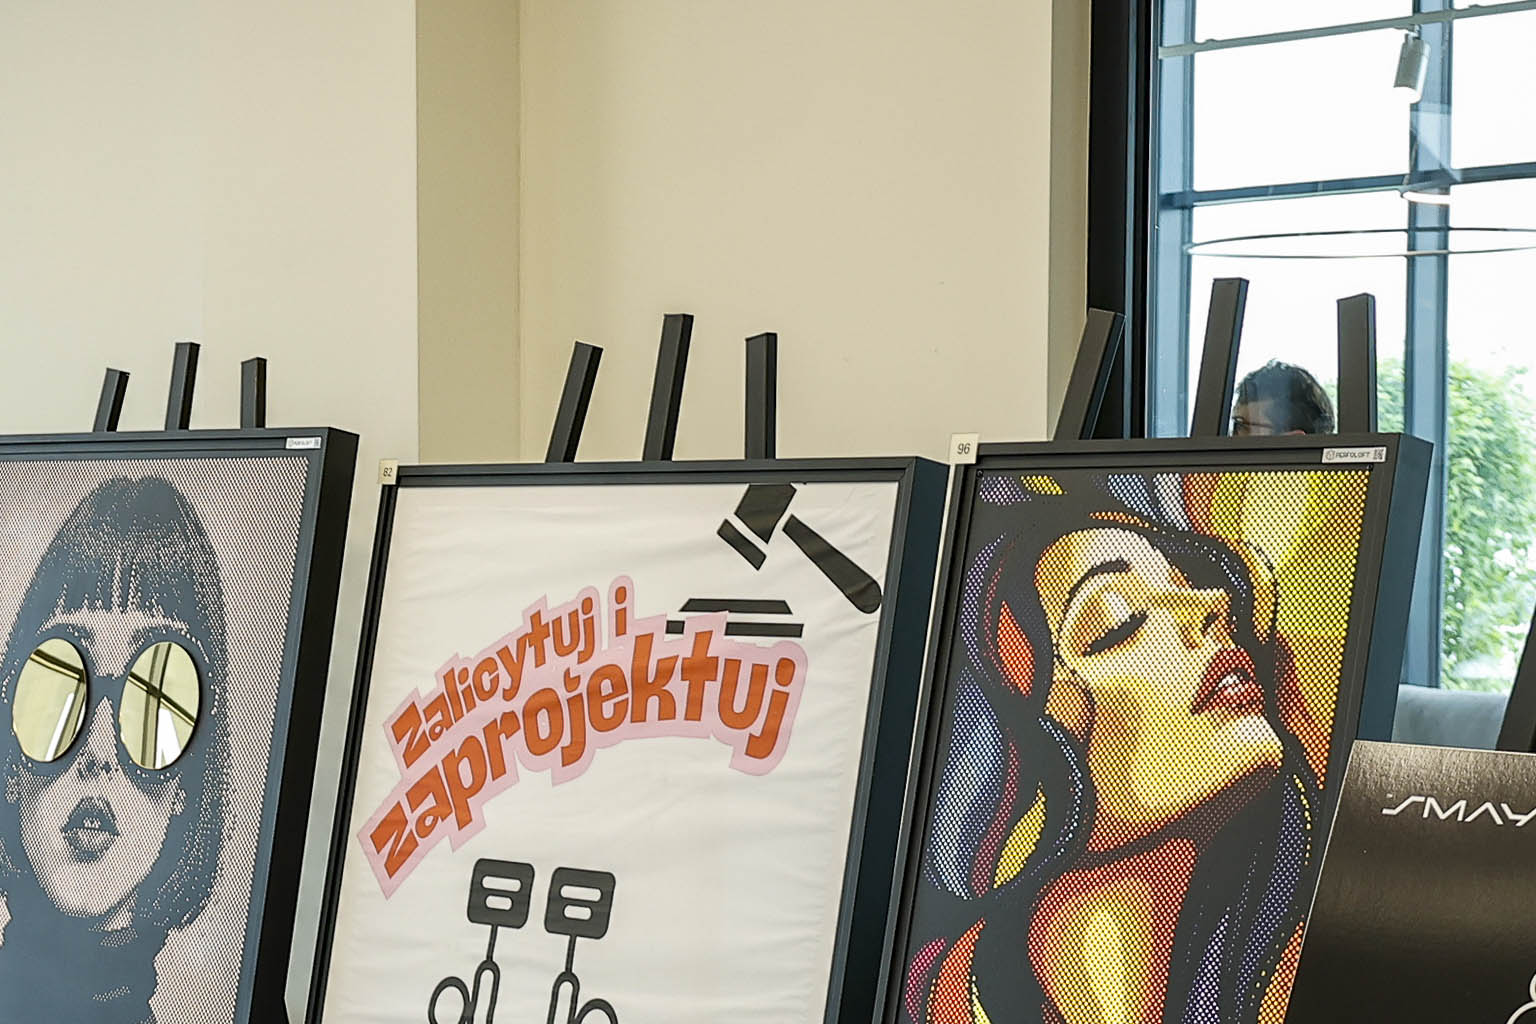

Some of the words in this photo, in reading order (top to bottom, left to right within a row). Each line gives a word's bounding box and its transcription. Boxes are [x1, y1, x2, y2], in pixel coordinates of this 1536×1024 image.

[383, 467, 393, 477] 82
[957, 442, 971, 455] 96
[391, 597, 595, 769] Zalicytuj
[615, 586, 627, 637] i
[369, 630, 796, 879] zaprojektuj
